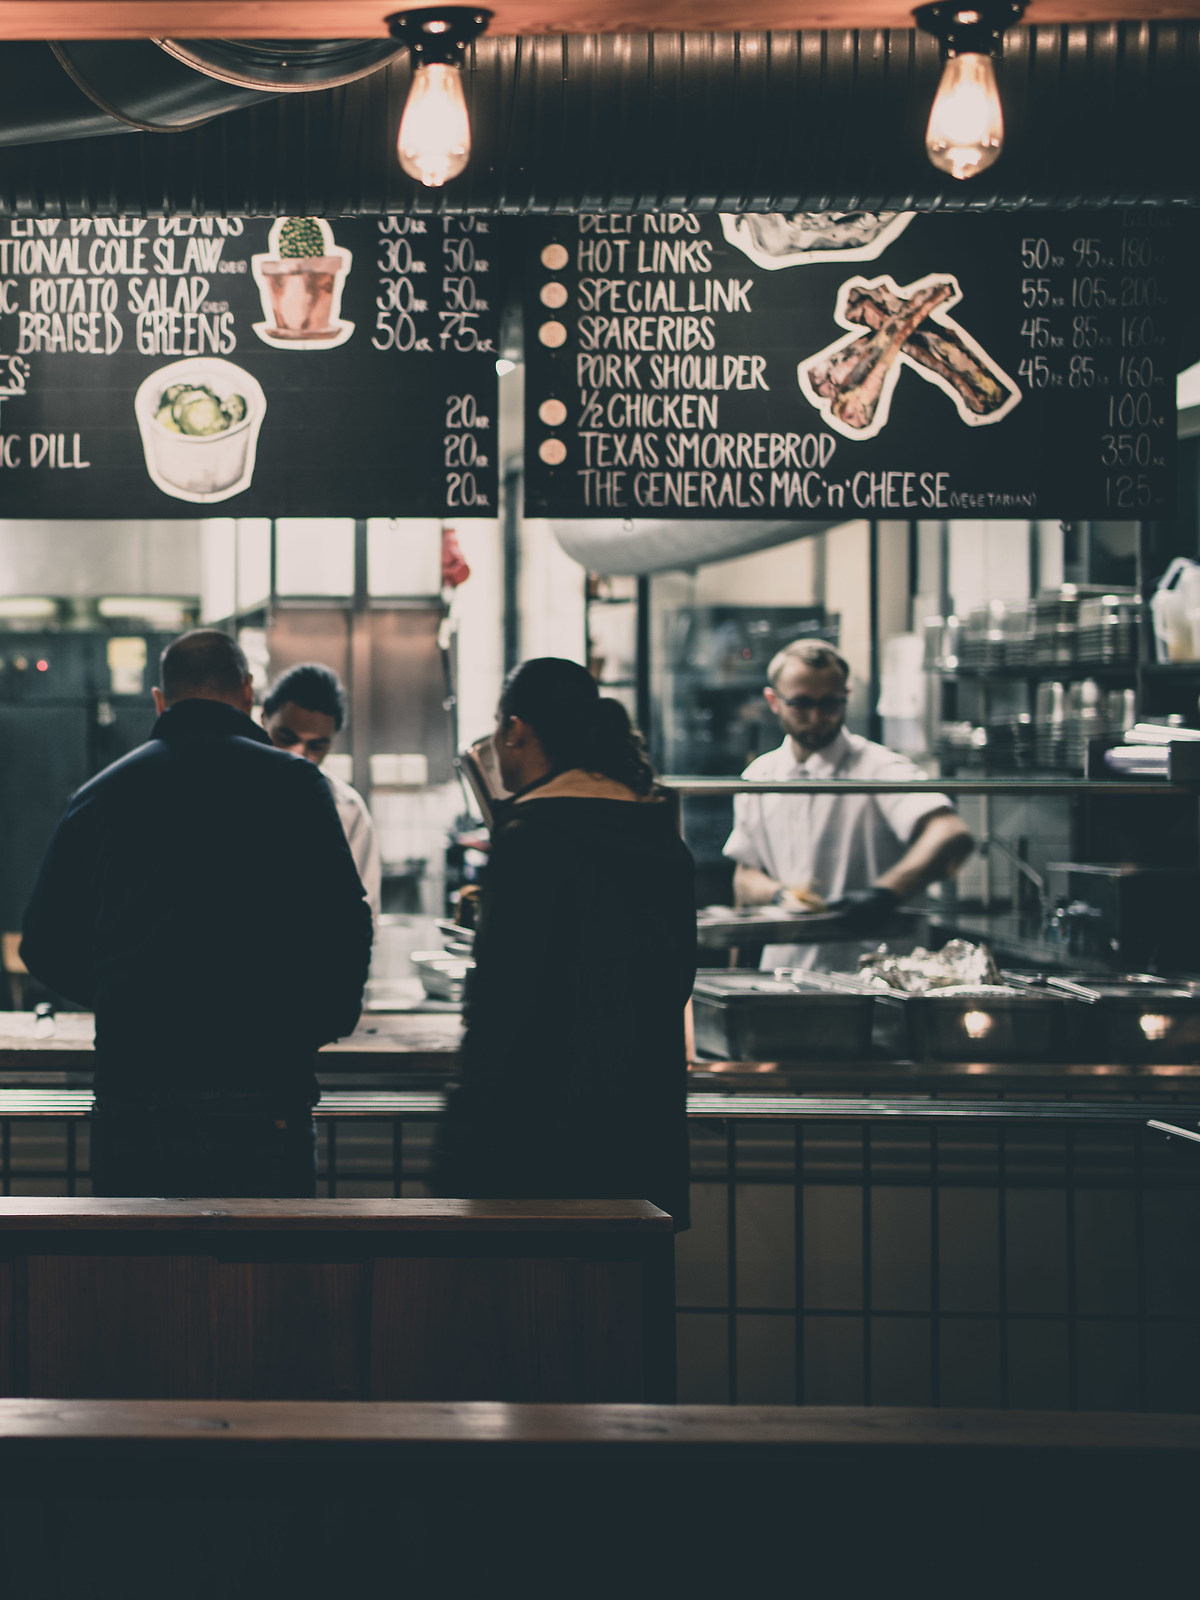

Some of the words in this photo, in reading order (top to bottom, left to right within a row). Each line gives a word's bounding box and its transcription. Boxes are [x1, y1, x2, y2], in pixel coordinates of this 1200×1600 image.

[89, 238, 150, 275] COLE
[152, 237, 226, 275] SLAW
[577, 239, 631, 273] HOT
[638, 240, 713, 274] LINKS
[30, 278, 118, 314] POTATO
[128, 276, 210, 314] SALAD
[577, 278, 686, 313] SPECIAL
[688, 279, 754, 313] LINK
[16, 312, 123, 355] BRAISED
[136, 311, 237, 355] GREENS
[577, 315, 716, 351] SPARERIBS
[577, 353, 642, 390] PORK
[650, 353, 771, 391] SHOULDER
[607, 393, 719, 430] CHICKEN
[30, 433, 91, 469] DILL
[577, 432, 660, 468] TEXAS
[665, 432, 836, 469] SMORREBROD
[577, 469, 629, 507] THE
[633, 470, 765, 508] GENERALS
